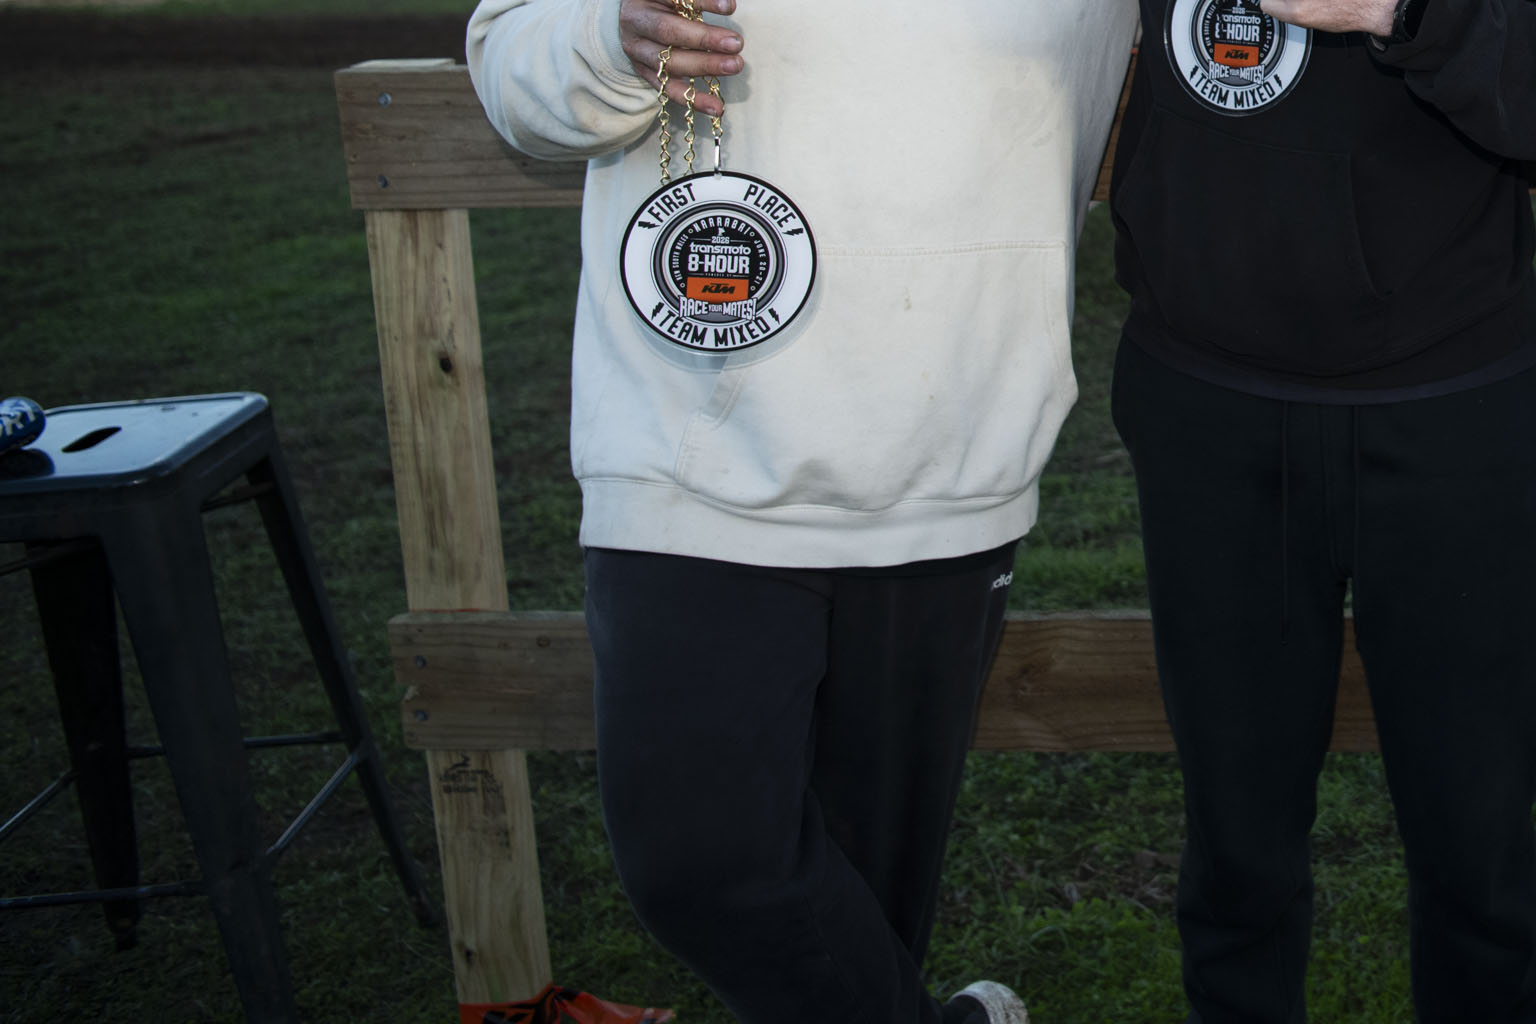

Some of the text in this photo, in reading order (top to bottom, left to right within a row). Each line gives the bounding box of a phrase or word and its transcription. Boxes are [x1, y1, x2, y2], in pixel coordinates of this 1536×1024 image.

[1225, 49, 1250, 60] KTM
[1208, 60, 1230, 80] RACE
[1240, 64, 1265, 85] MATES!
[1195, 74, 1276, 109] TEAM MIXED
[647, 183, 797, 228] FIRST PLACE
[689, 242, 751, 255] transmoto
[711, 236, 730, 244] 2026
[687, 253, 750, 274] 8-HOUR
[754, 239, 767, 285] JUNE 20-21
[701, 282, 735, 294] KTM
[679, 296, 757, 321] RACE YOUR MATES!
[659, 310, 771, 347] TEAM MIXED
